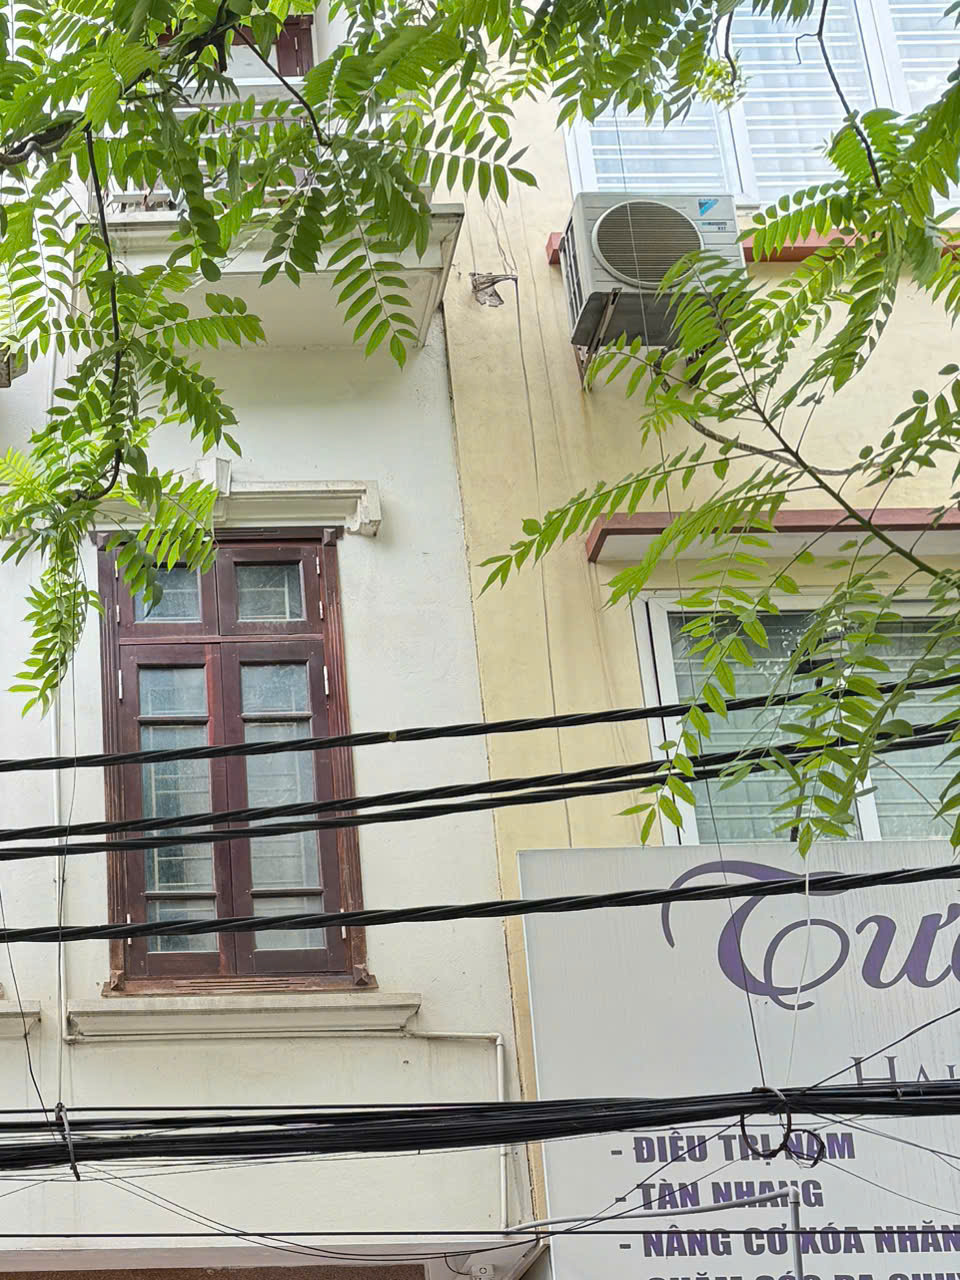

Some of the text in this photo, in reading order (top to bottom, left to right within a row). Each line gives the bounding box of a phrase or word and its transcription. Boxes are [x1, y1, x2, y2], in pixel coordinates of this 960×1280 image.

[661, 860, 960, 1010] Tư
[718, 1133, 771, 1166] TRỊ
[638, 1179, 824, 1210] TÀN NHANG
[643, 1225, 732, 1257] NÂNG
[743, 1223, 788, 1256] CƠ
[799, 1222, 865, 1254] XÓA
